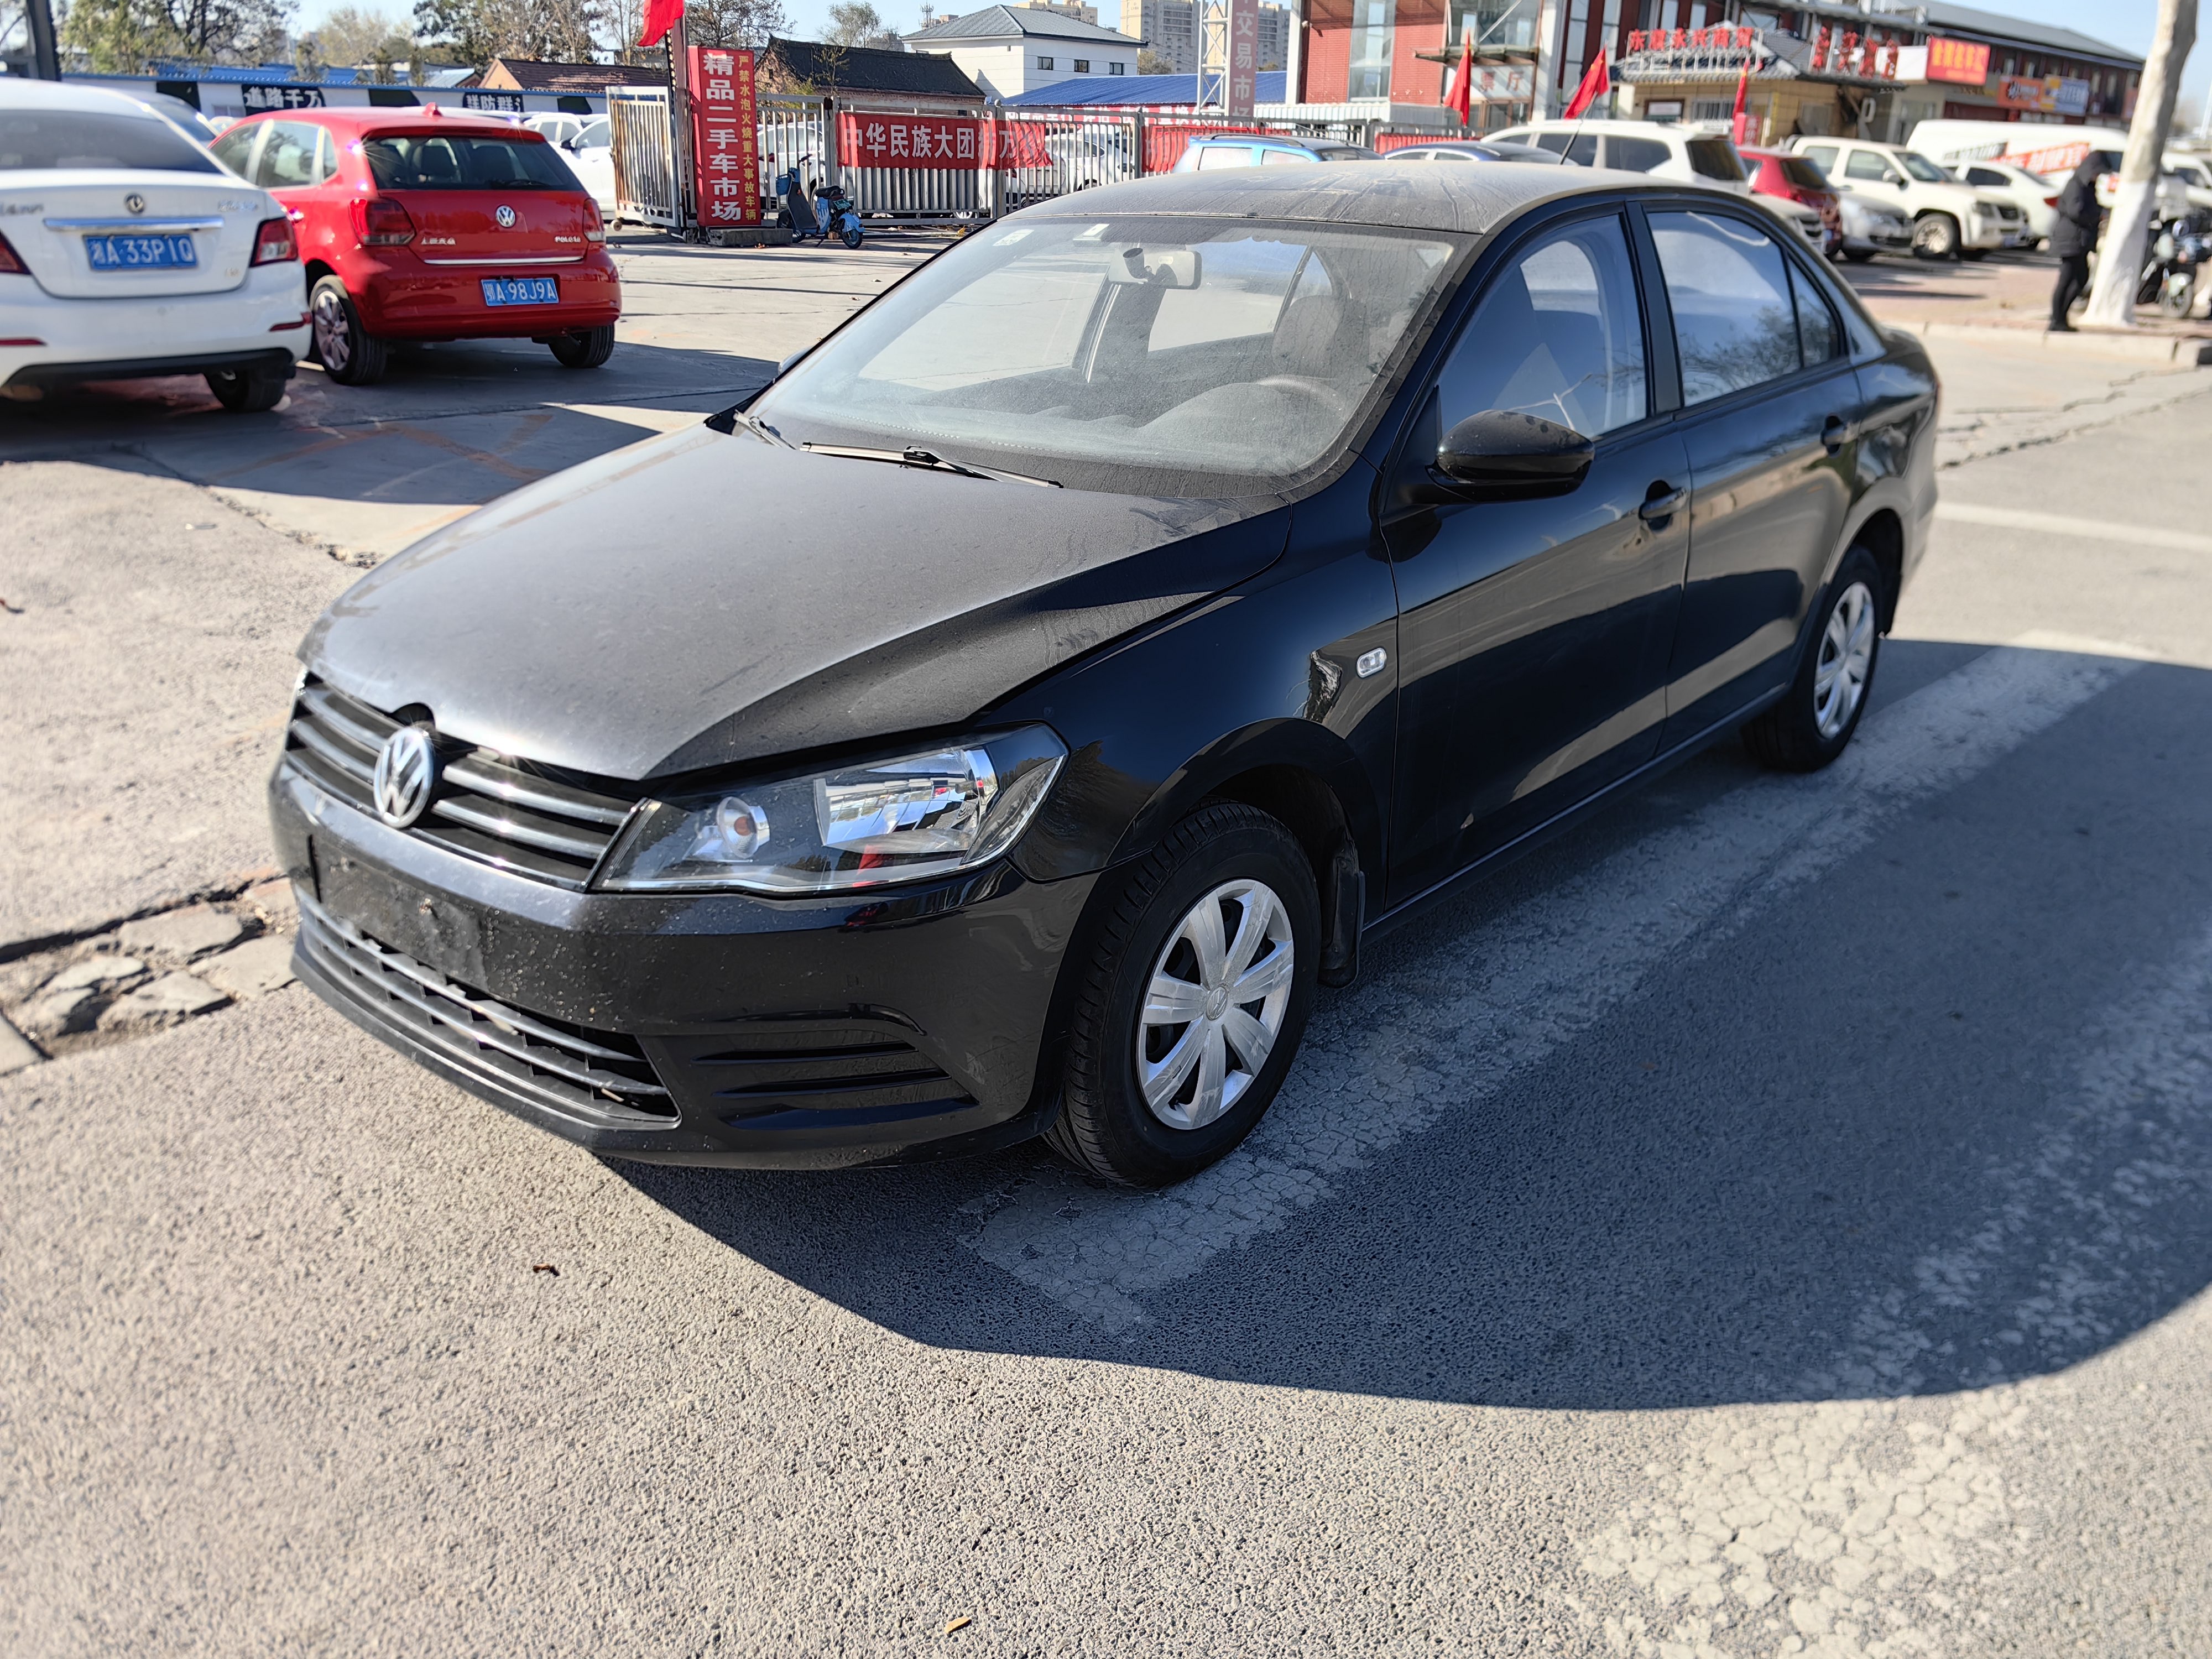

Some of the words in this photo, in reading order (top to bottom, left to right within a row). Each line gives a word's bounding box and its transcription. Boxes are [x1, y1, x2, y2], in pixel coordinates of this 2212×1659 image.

[703, 55, 741, 221] 精品二手车市场
[739, 56, 757, 221] 严禁水泡火烧重大事故车辆
[1232, 0, 1255, 127] 交易市场
